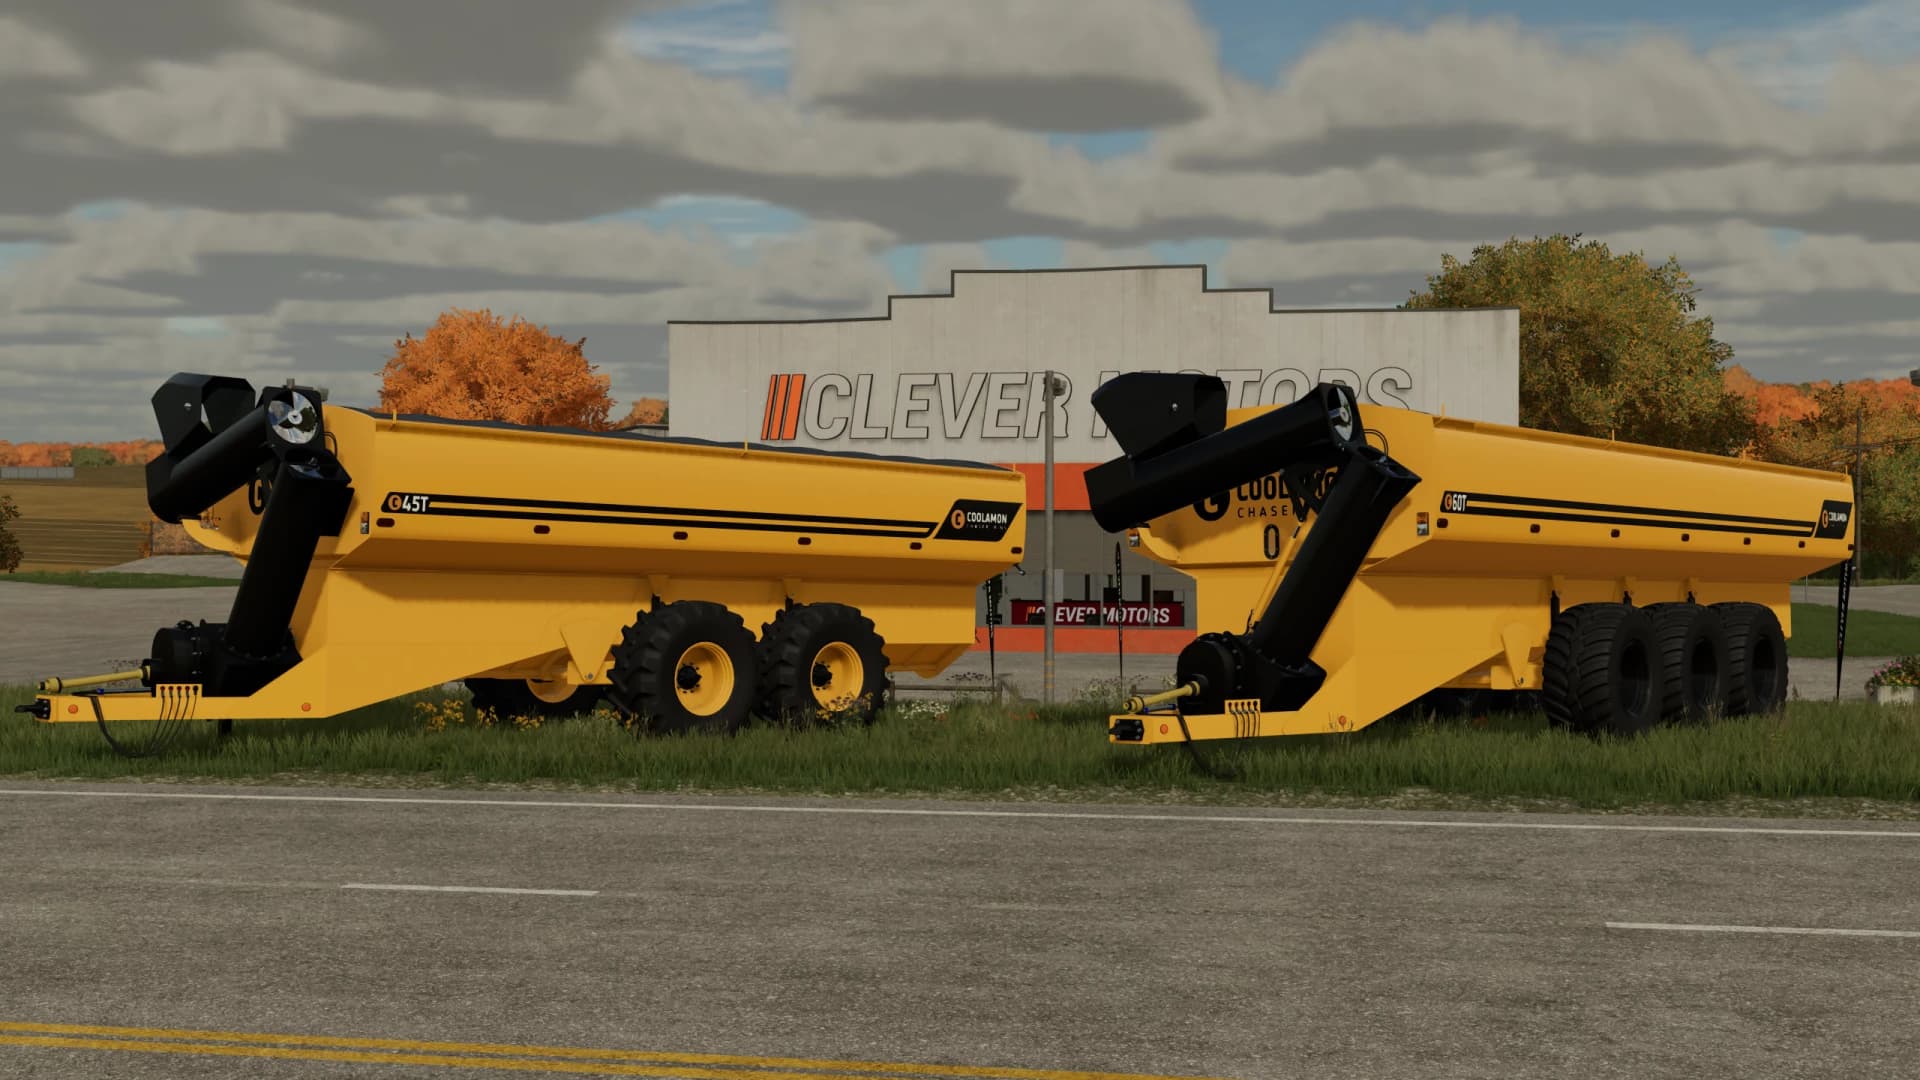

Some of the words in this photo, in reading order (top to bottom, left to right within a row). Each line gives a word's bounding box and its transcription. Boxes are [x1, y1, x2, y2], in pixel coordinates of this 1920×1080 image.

[803, 371, 1073, 441] CLEVER
[1091, 366, 1413, 439] TOS
[402, 495, 430, 512] 45T
[1237, 505, 1296, 518] CHASE
[1452, 494, 1468, 512] 60T
[967, 511, 1008, 524] COOLAMON
[1036, 606, 1097, 623] EVE
[1103, 607, 1171, 624] MOTORS
